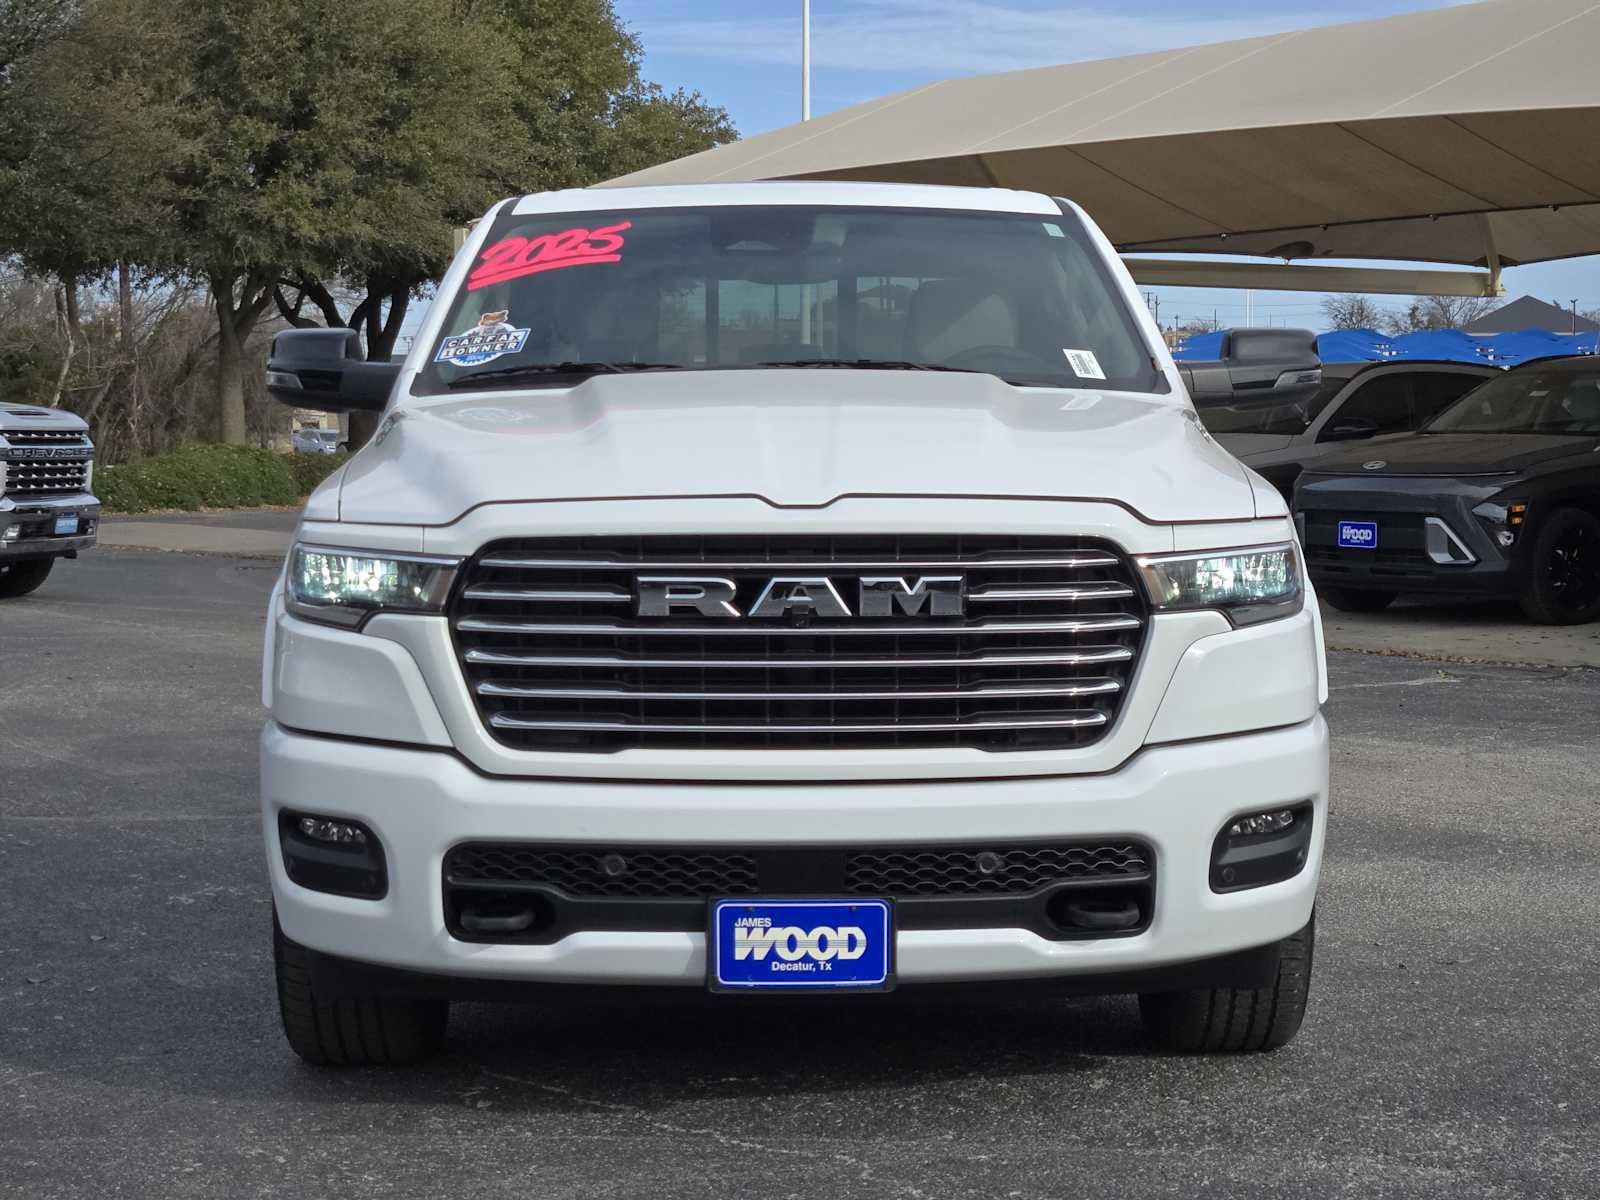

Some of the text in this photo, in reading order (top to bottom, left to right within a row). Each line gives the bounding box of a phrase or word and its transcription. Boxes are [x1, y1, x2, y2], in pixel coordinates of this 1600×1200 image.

[470, 219, 632, 280] 2025
[447, 333, 521, 348] CARFAX
[456, 342, 518, 356] OWNER
[1342, 528, 1372, 540] WOOD
[637, 576, 964, 617] RAM
[734, 917, 772, 927] JAMES
[734, 926, 867, 961] WOOD
[771, 961, 832, 972] Decatur, Tx
